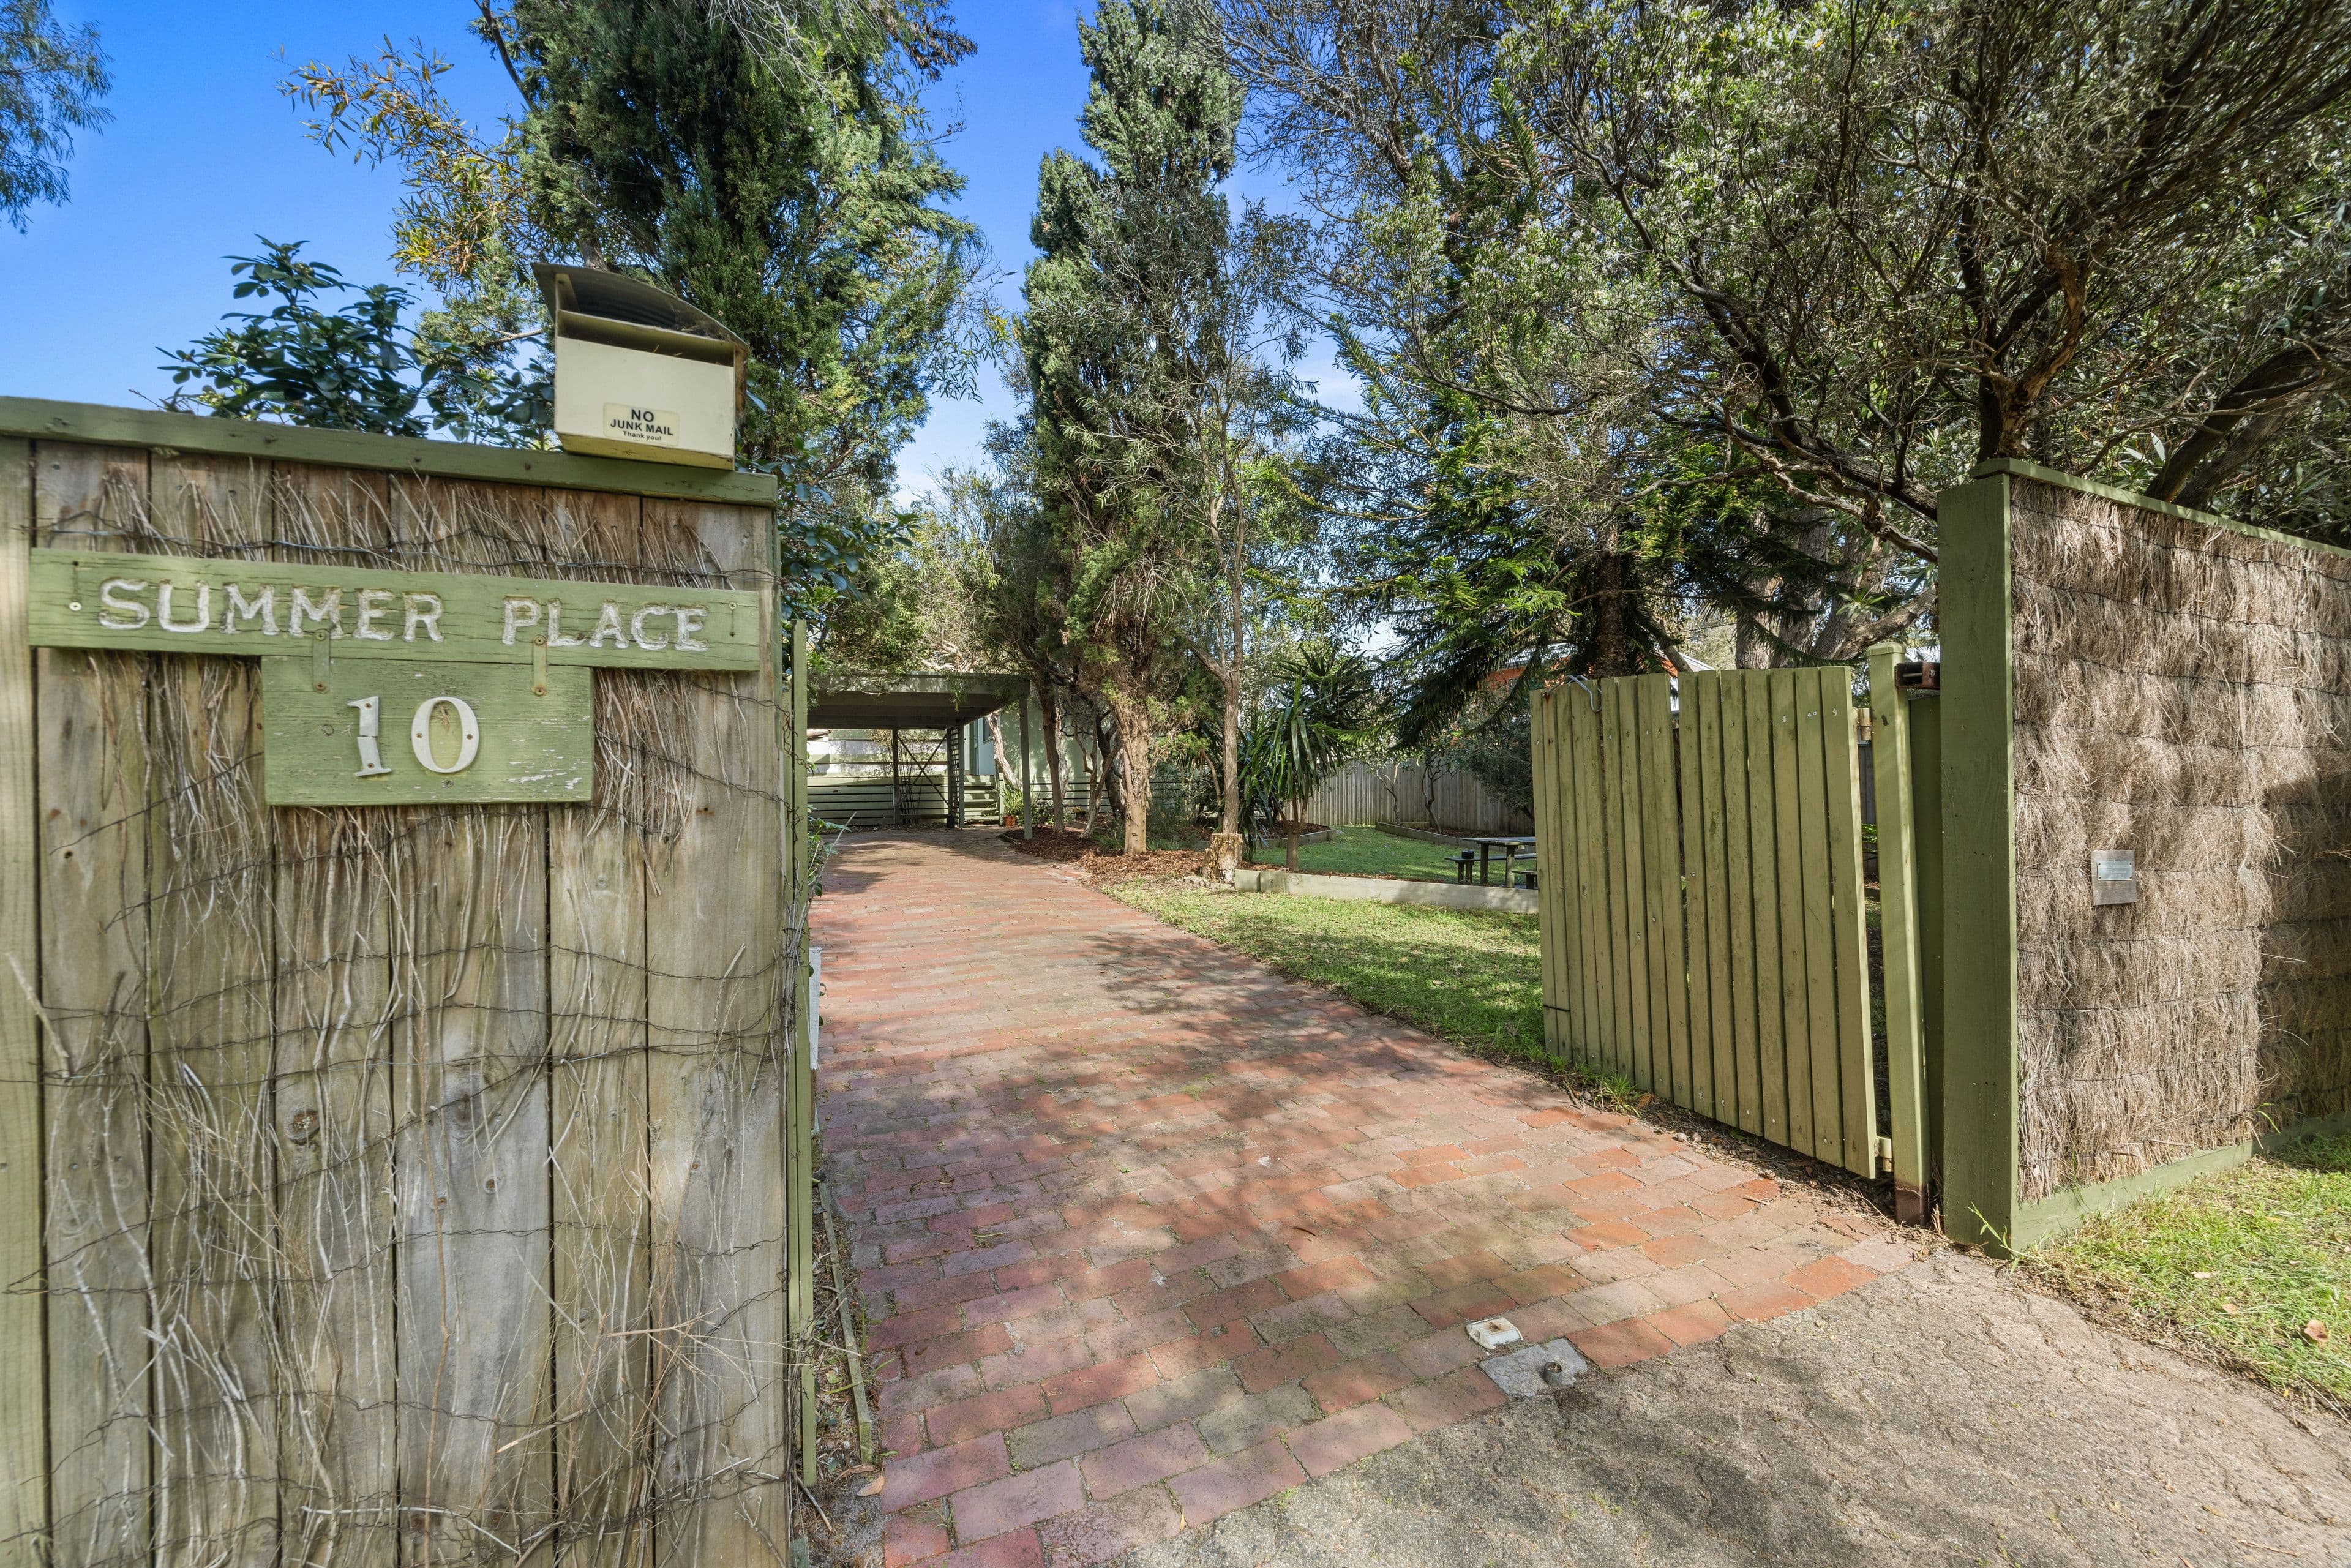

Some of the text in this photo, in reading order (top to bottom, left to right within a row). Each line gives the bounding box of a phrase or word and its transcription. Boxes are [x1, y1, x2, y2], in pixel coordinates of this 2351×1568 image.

[610, 419, 673, 435] JUNK MAIL
[631, 409, 654, 422] NO
[100, 578, 710, 651] SUMMER PLACE
[347, 696, 480, 777] 10
